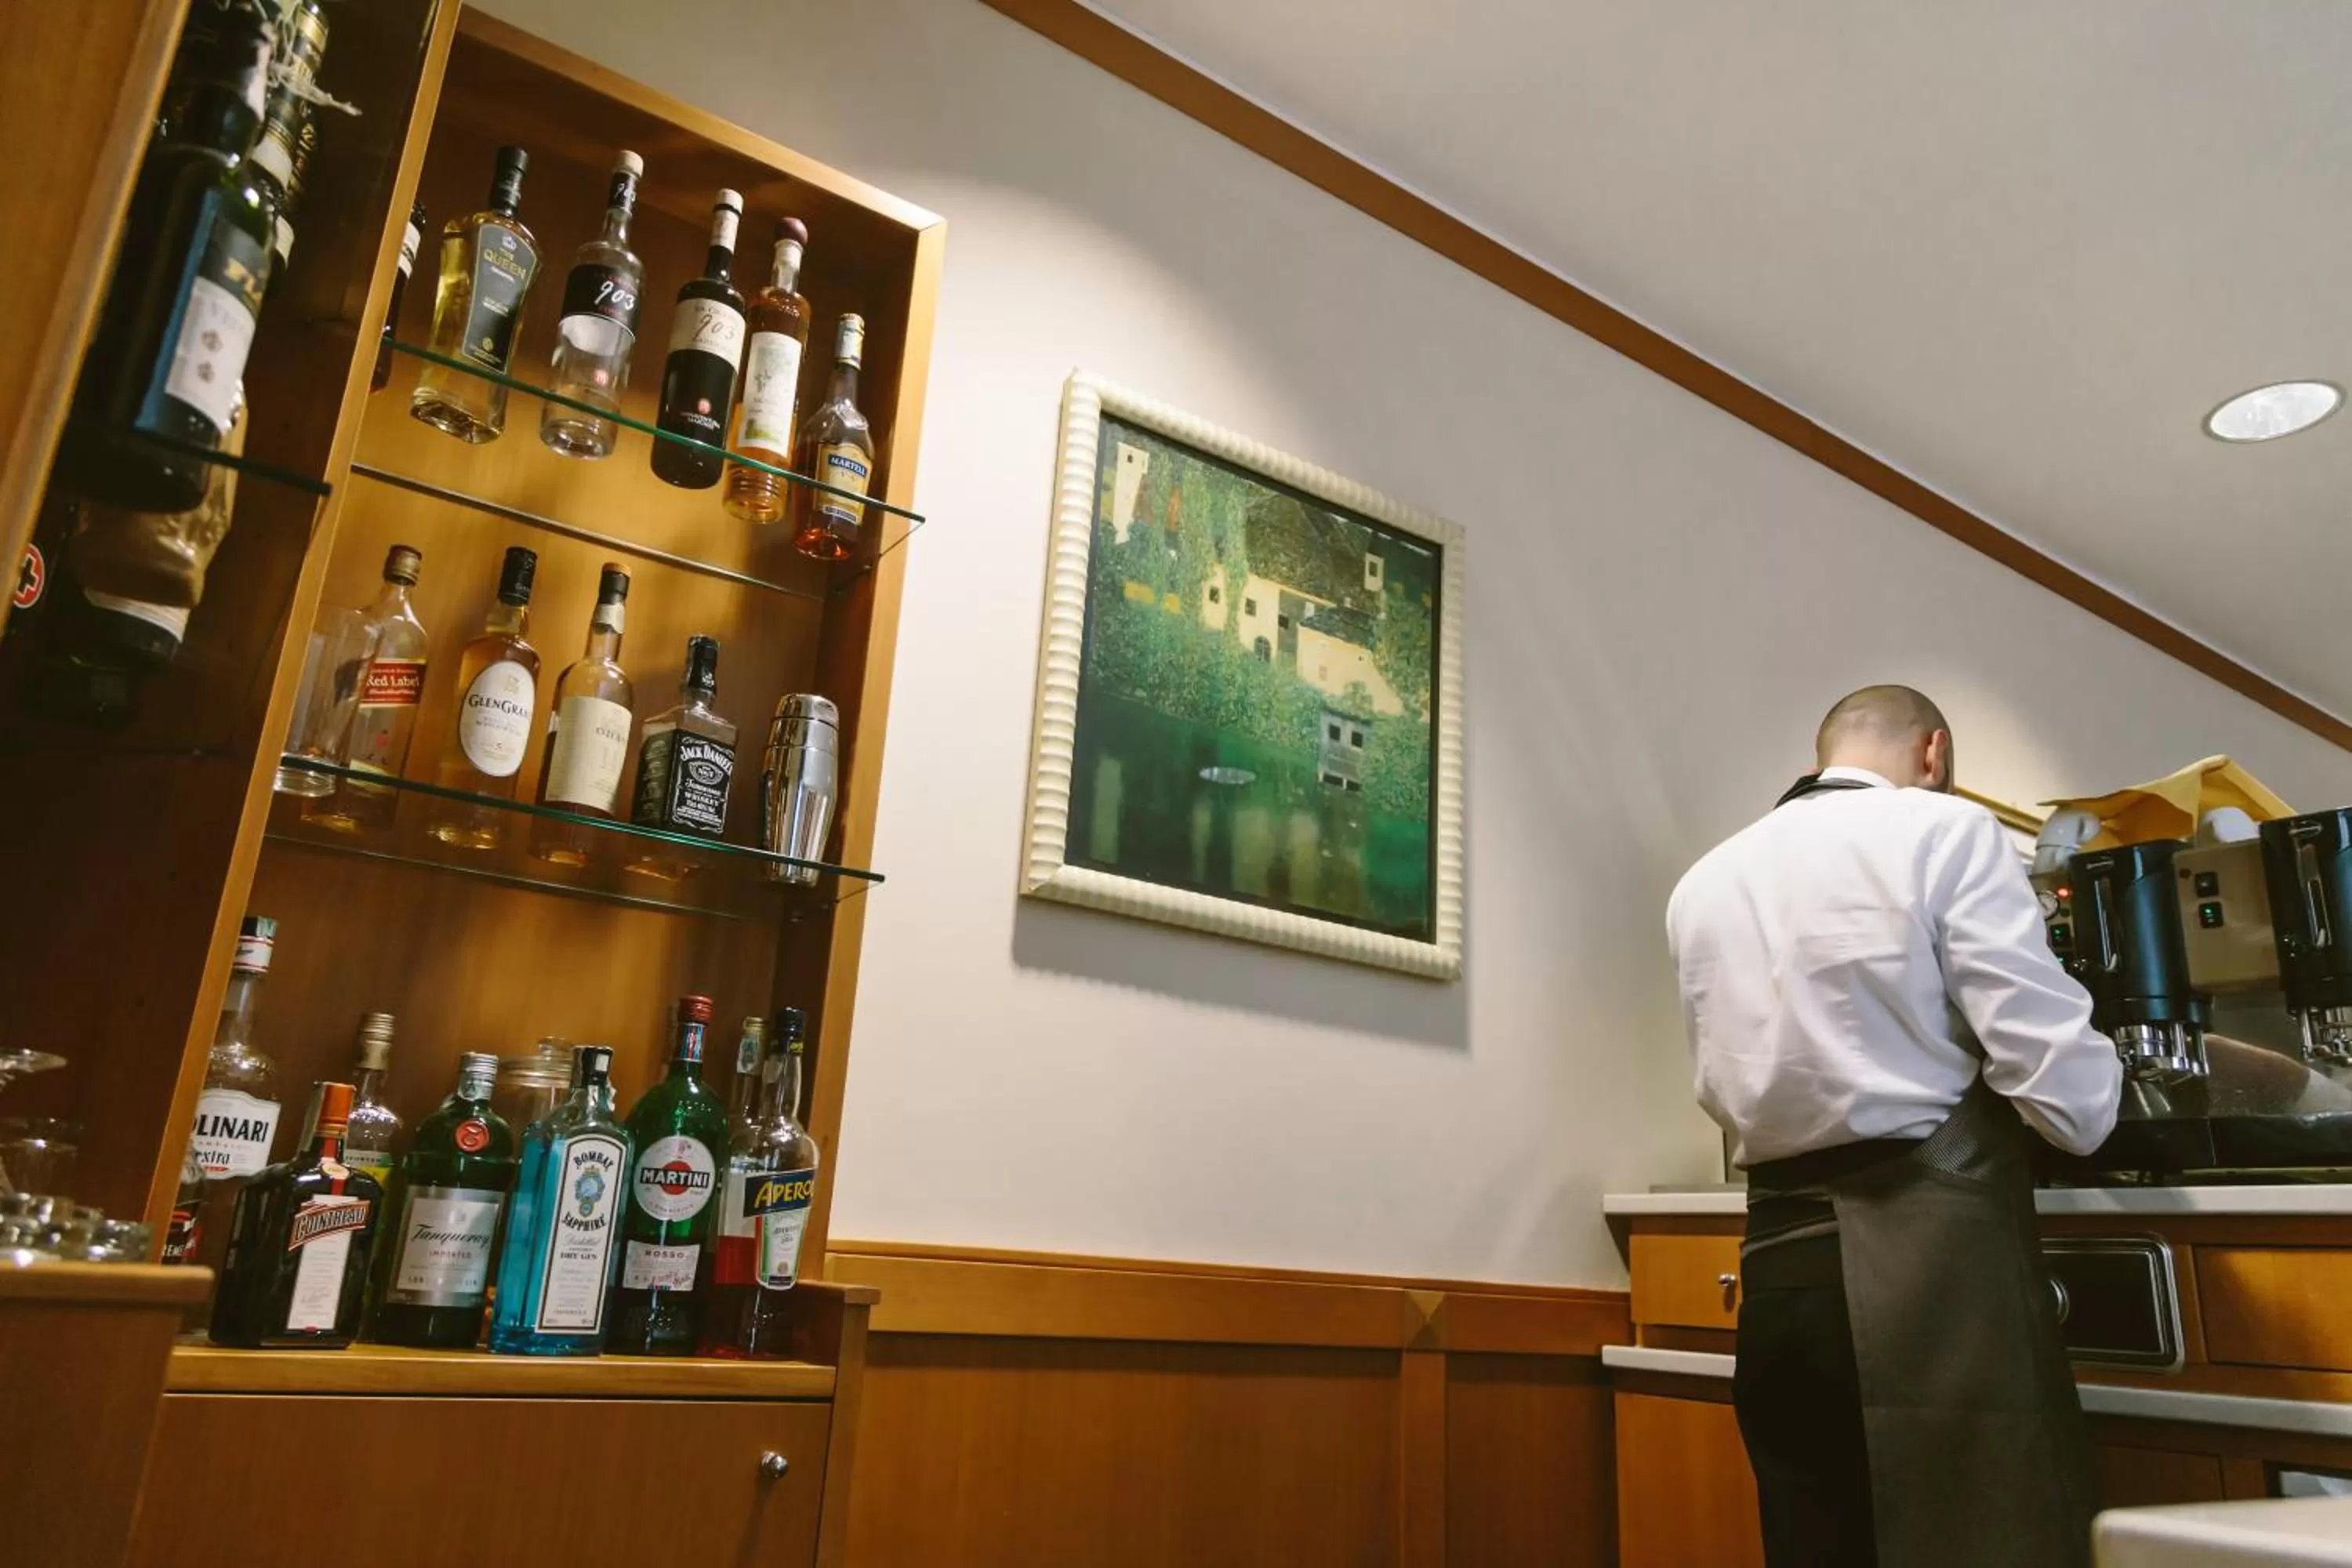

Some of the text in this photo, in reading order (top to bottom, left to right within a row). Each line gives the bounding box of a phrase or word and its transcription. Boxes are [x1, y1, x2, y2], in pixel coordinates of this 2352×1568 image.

[484, 248, 527, 280] QUEEN
[593, 281, 635, 310] 903
[366, 674, 419, 688] Red Label
[680, 745, 703, 762] JACK
[192, 1114, 269, 1143] LINARI
[573, 1150, 614, 1171] BOMBAY
[642, 1168, 709, 1187] MARTINI
[296, 1207, 366, 1240] COINTREAU
[561, 1211, 607, 1232] SAPPHIRE
[410, 1223, 490, 1250] Tanqueray
